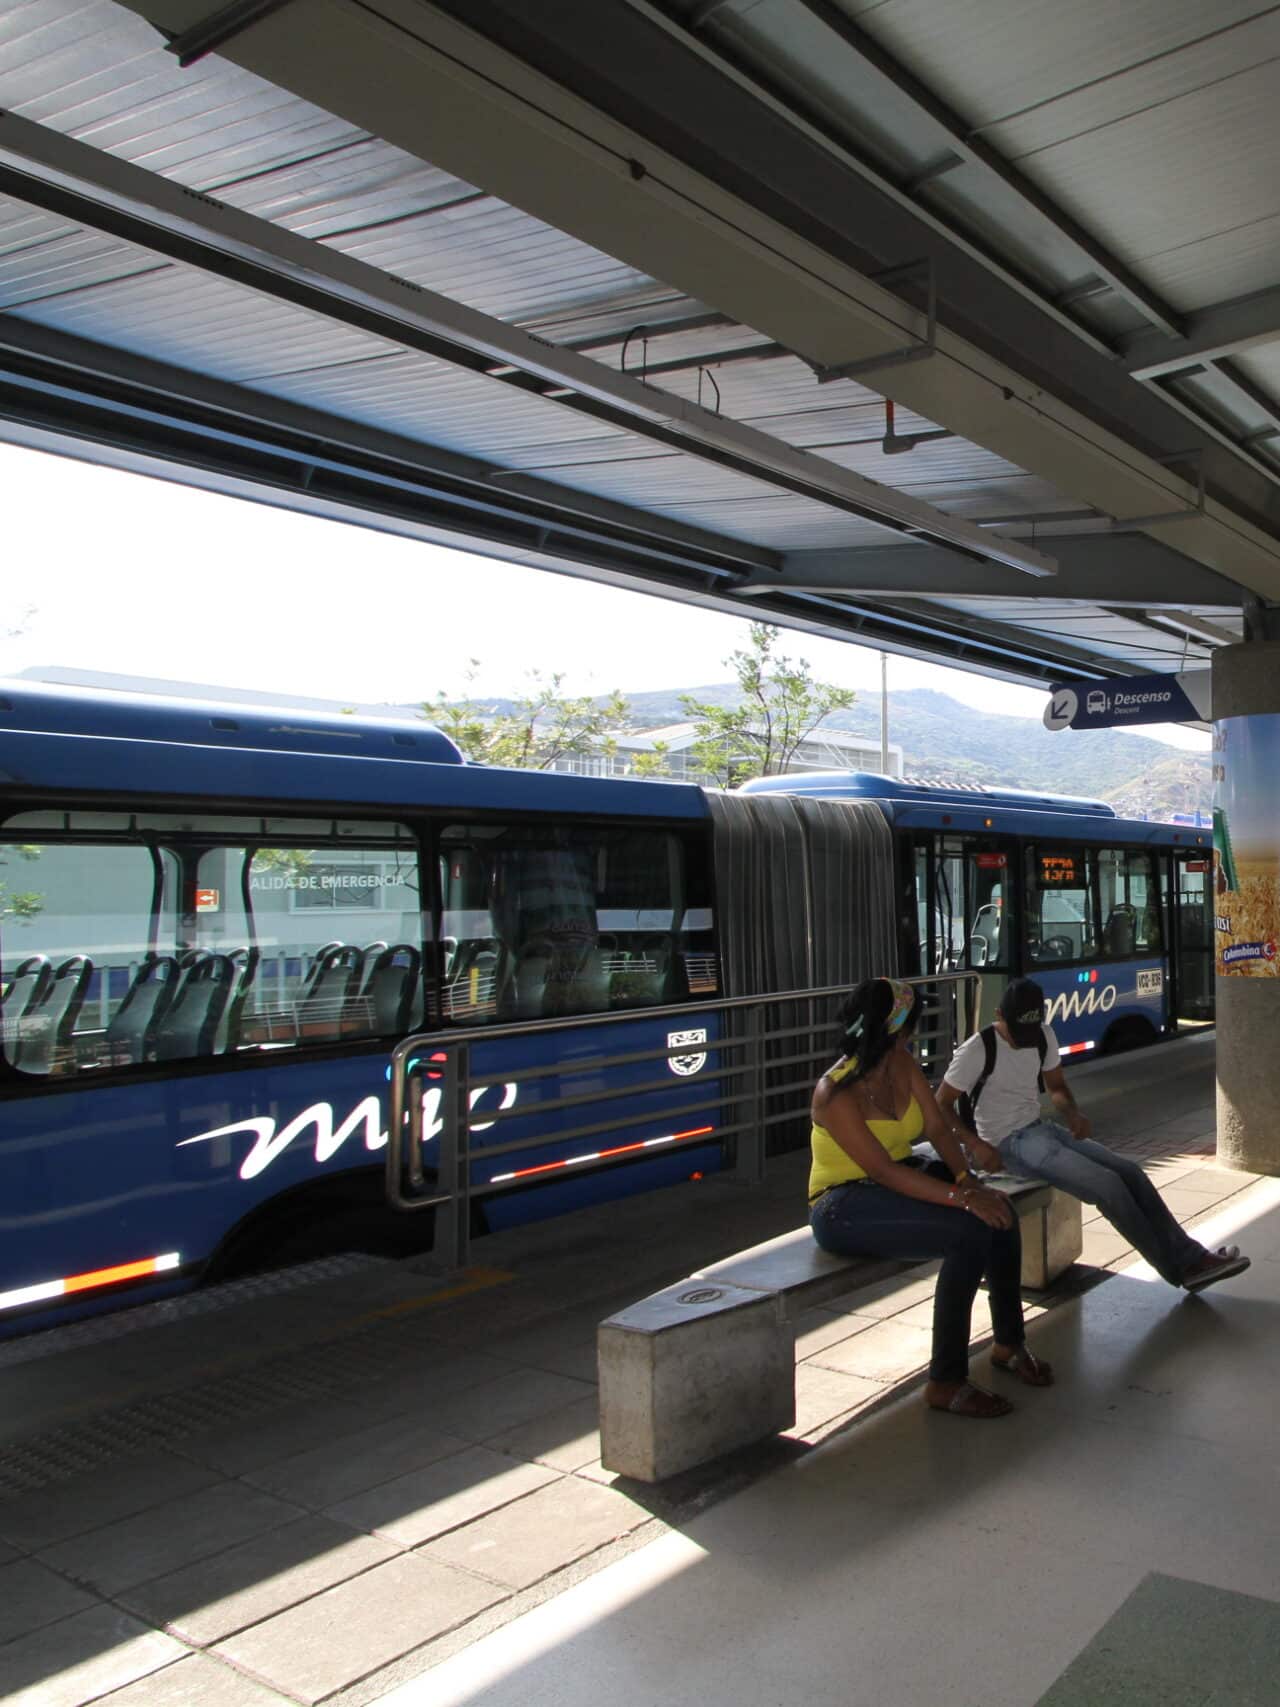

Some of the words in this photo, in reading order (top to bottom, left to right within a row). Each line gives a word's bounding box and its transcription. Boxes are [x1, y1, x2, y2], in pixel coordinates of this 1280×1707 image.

[1114, 691, 1171, 706] Descenso
[250, 875, 292, 890] ALIDA
[299, 875, 317, 889] DE
[321, 873, 404, 889] EMERGENCIA
